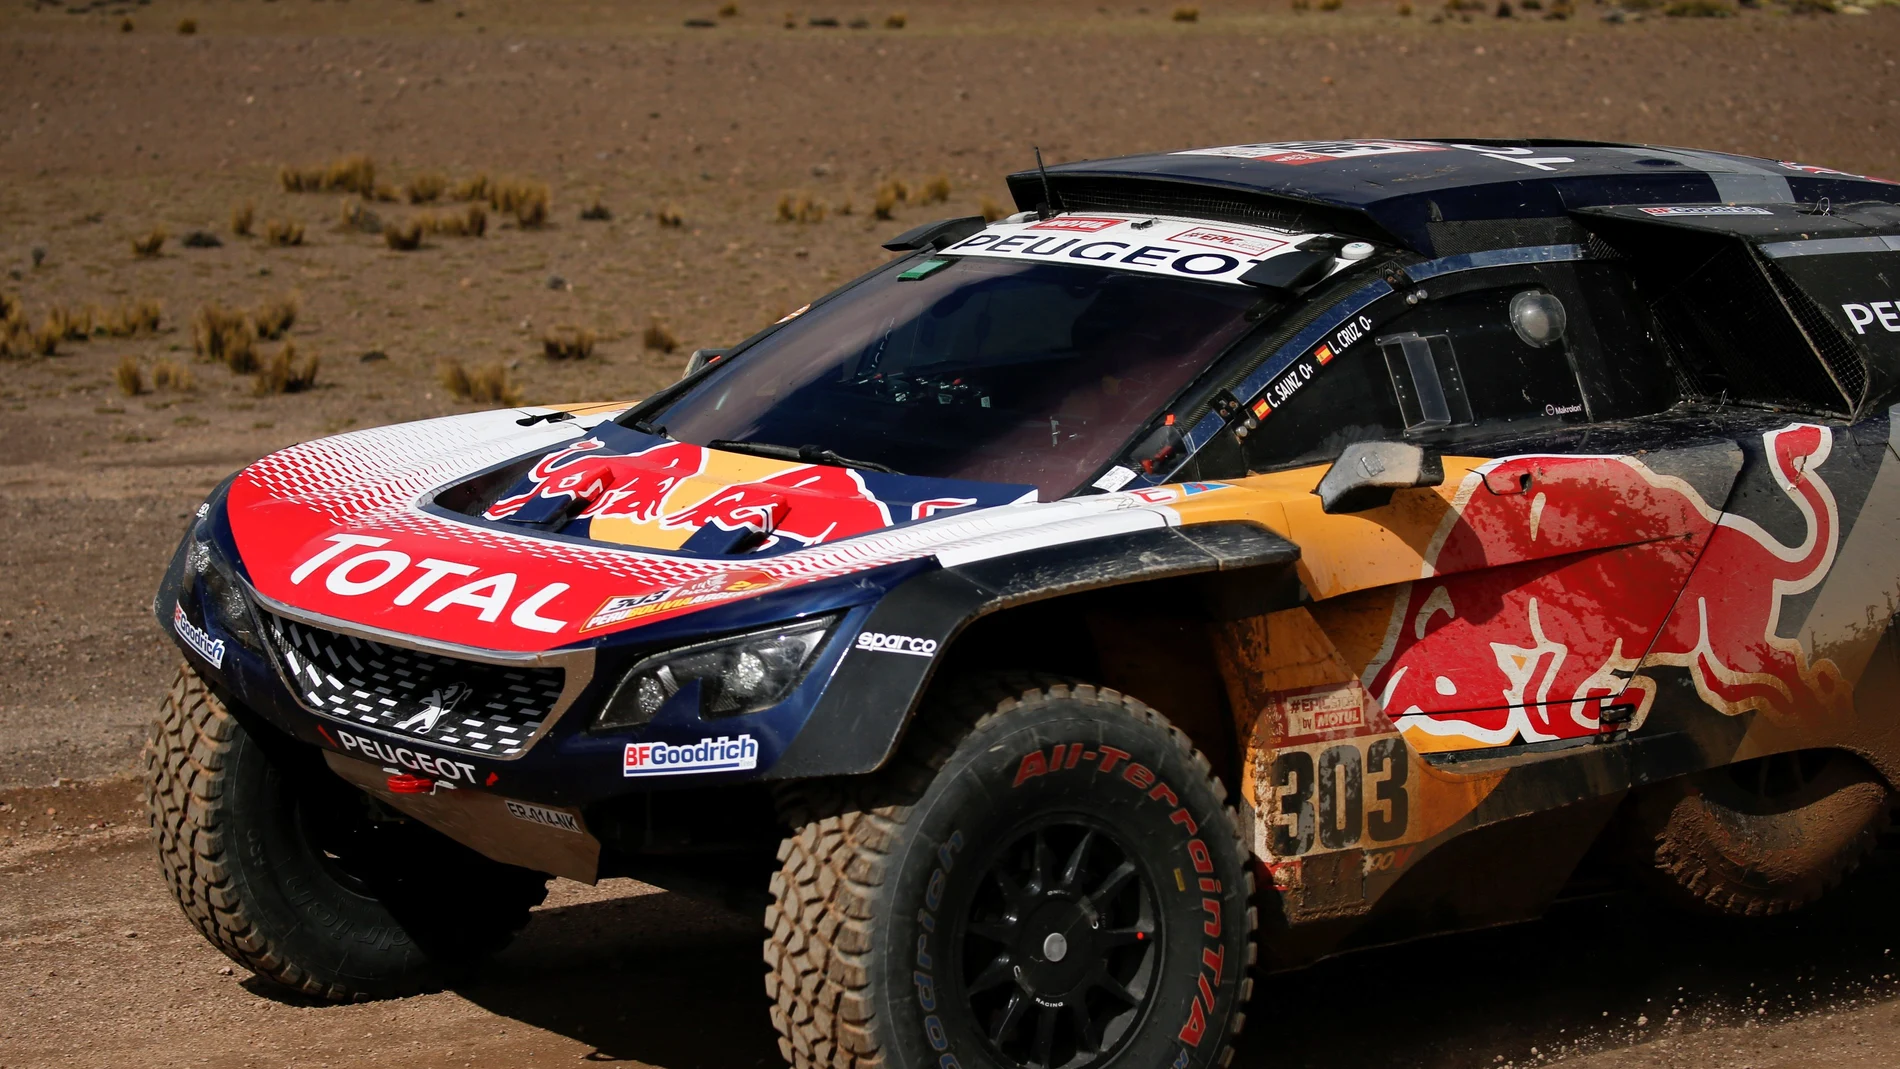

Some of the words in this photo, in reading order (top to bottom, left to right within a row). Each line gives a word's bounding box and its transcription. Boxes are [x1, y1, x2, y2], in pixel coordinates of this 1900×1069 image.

[952, 234, 1260, 275] PEUGEO
[1841, 301, 1900, 335] PE
[1328, 340, 1342, 355] L.
[1336, 322, 1362, 348] CRUZ
[1266, 392, 1281, 408] C.
[1274, 371, 1303, 401] SAINZ
[1555, 405, 1581, 415] Makrolon
[290, 533, 571, 634] TOTAL
[608, 589, 671, 611] 303
[857, 630, 937, 653] sparco
[1302, 717, 1312, 729] by
[1317, 710, 1359, 727] MOTUL
[337, 729, 476, 784] PEUGEOT
[626, 736, 755, 766] BFGoodrich
[1271, 738, 1409, 856] 303
[507, 802, 579, 831] ER-014-NK
[1035, 997, 1063, 1007] RACING
